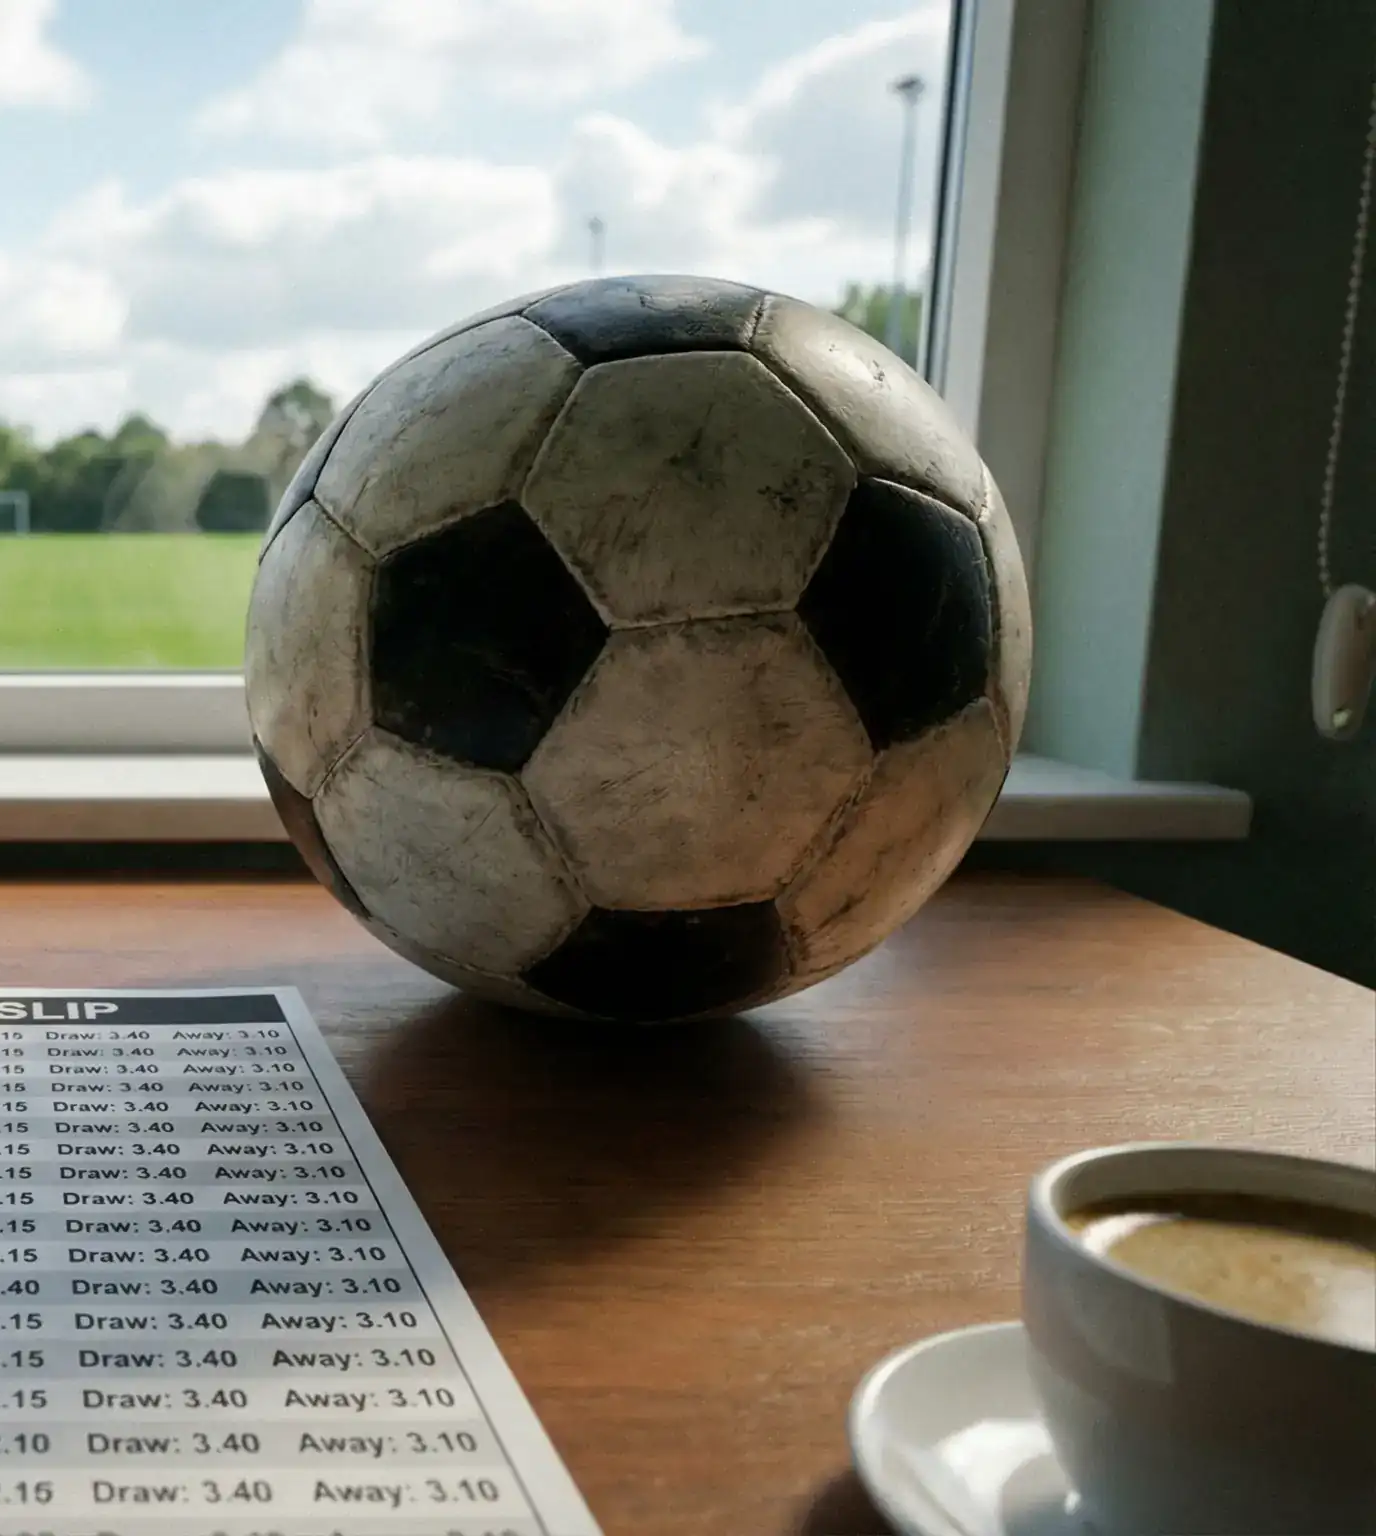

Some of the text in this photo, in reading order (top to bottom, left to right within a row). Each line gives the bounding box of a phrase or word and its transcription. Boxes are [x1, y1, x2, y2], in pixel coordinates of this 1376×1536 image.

[51, 1082, 112, 1093] Draw:
[119, 1082, 164, 1092] 3.40
[188, 1082, 252, 1094] Away:
[259, 1081, 304, 1092] 3.10
[53, 1101, 115, 1112] Draw:
[124, 1101, 169, 1112] 3.40
[195, 1101, 260, 1115] Away:
[267, 1100, 313, 1112] 3.10
[55, 1122, 119, 1134] Draw:
[128, 1122, 174, 1134] 3.40
[201, 1122, 268, 1136] Away:
[275, 1121, 323, 1132] 3.10
[57, 1144, 124, 1156] Draw:
[132, 1143, 180, 1155] 3.40
[207, 1143, 277, 1158] Away:
[284, 1142, 334, 1155] 3.10
[60, 1166, 128, 1180] Draw:
[136, 1166, 187, 1180] 3.40
[215, 1166, 287, 1182] Away:
[293, 1165, 345, 1179] 3.10
[63, 1192, 133, 1205] Draw:
[142, 1192, 194, 1205] 3.40
[223, 1192, 298, 1207] Away:
[305, 1191, 358, 1204] 3.10
[66, 1219, 139, 1233] Draw:
[148, 1219, 202, 1234] 3.40
[231, 1218, 309, 1236] Away:
[316, 1218, 371, 1232] 3.10
[68, 1248, 144, 1263] Draw:
[154, 1248, 210, 1263] 3.40
[240, 1247, 321, 1266] Away:
[328, 1246, 385, 1262] 3.10
[72, 1279, 151, 1295] Draw:
[160, 1278, 218, 1295] 3.40
[250, 1279, 333, 1298] Away:
[341, 1278, 400, 1294] 3.10
[75, 1313, 157, 1330] Draw:
[168, 1312, 228, 1330] 3.40
[261, 1312, 347, 1333] Away:
[356, 1311, 415, 1329] 3.10
[79, 1350, 164, 1368] Draw:
[175, 1349, 238, 1368] 3.40
[272, 1349, 363, 1372] Away:
[371, 1348, 434, 1367] 3.10
[82, 1389, 171, 1409] Draw:
[182, 1389, 248, 1408] 3.40
[284, 1389, 378, 1412] Away:
[388, 1388, 455, 1407] 3.10
[87, 1432, 180, 1454] Draw:
[193, 1432, 260, 1454] 3.40
[299, 1432, 397, 1459] Away:
[406, 1432, 477, 1453] 3.10
[92, 1480, 189, 1504] Draw:
[202, 1480, 273, 1504] 3.40
[313, 1480, 414, 1509] Away:
[425, 1479, 498, 1503] 3.10
